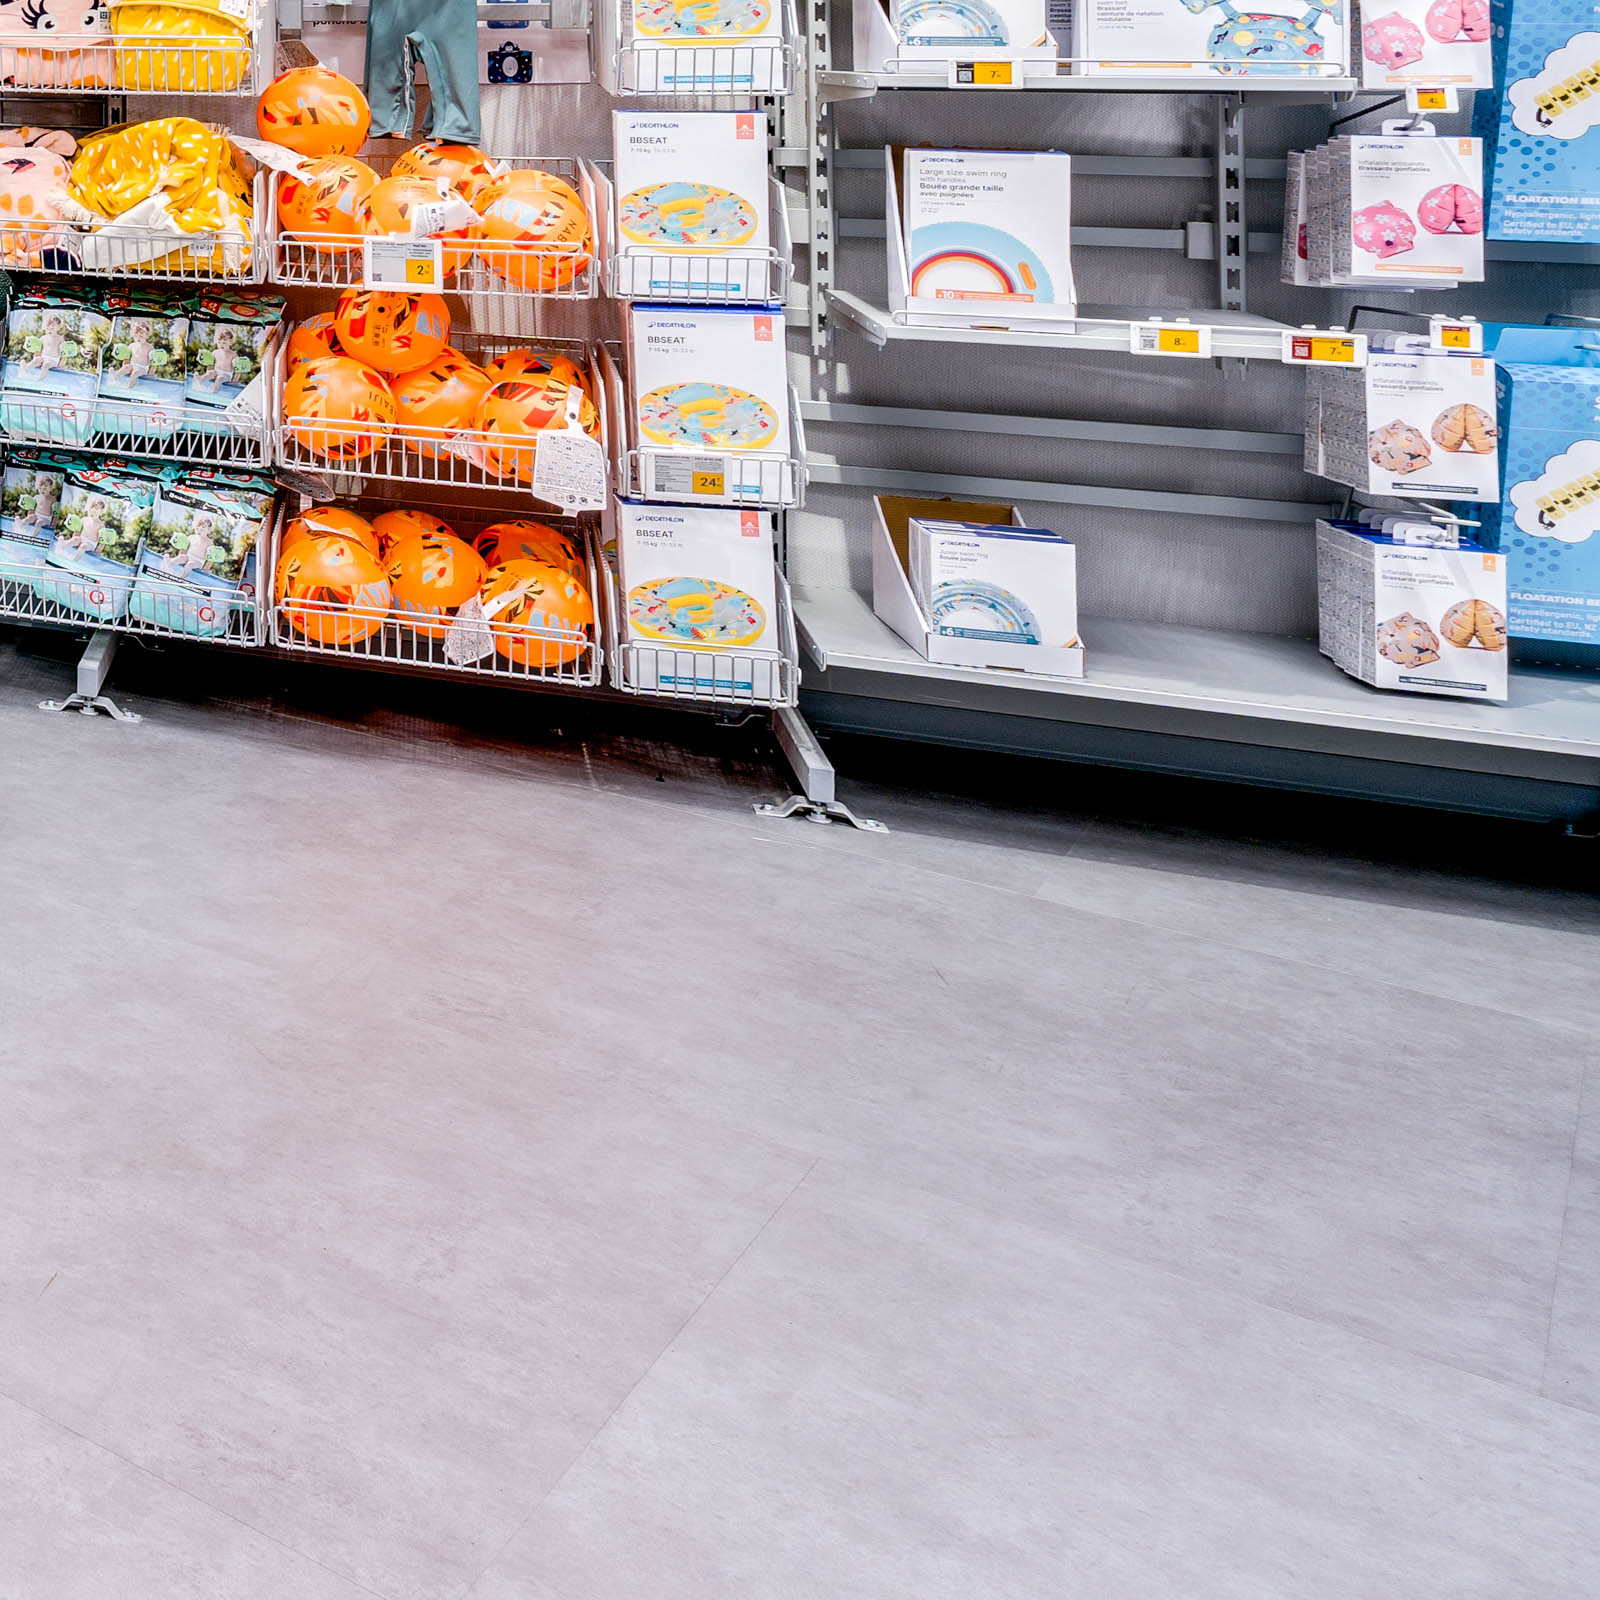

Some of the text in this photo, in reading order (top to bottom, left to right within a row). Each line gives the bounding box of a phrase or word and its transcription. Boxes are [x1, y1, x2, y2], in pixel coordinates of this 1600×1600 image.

[629, 136, 668, 146] BBSEAT
[919, 168, 945, 178] Large
[946, 169, 964, 177] size
[990, 170, 1008, 179] ring
[949, 184, 981, 193] grande
[982, 184, 1005, 193] taille
[1505, 195, 1579, 205] FLOATATION
[656, 322, 697, 330] DECATHLON
[647, 335, 686, 345] BBSEAT
[699, 476, 718, 488] 24
[645, 516, 685, 524] DECATHLON
[635, 529, 674, 539] BBSEAT
[1510, 592, 1585, 605] FLOATATION
